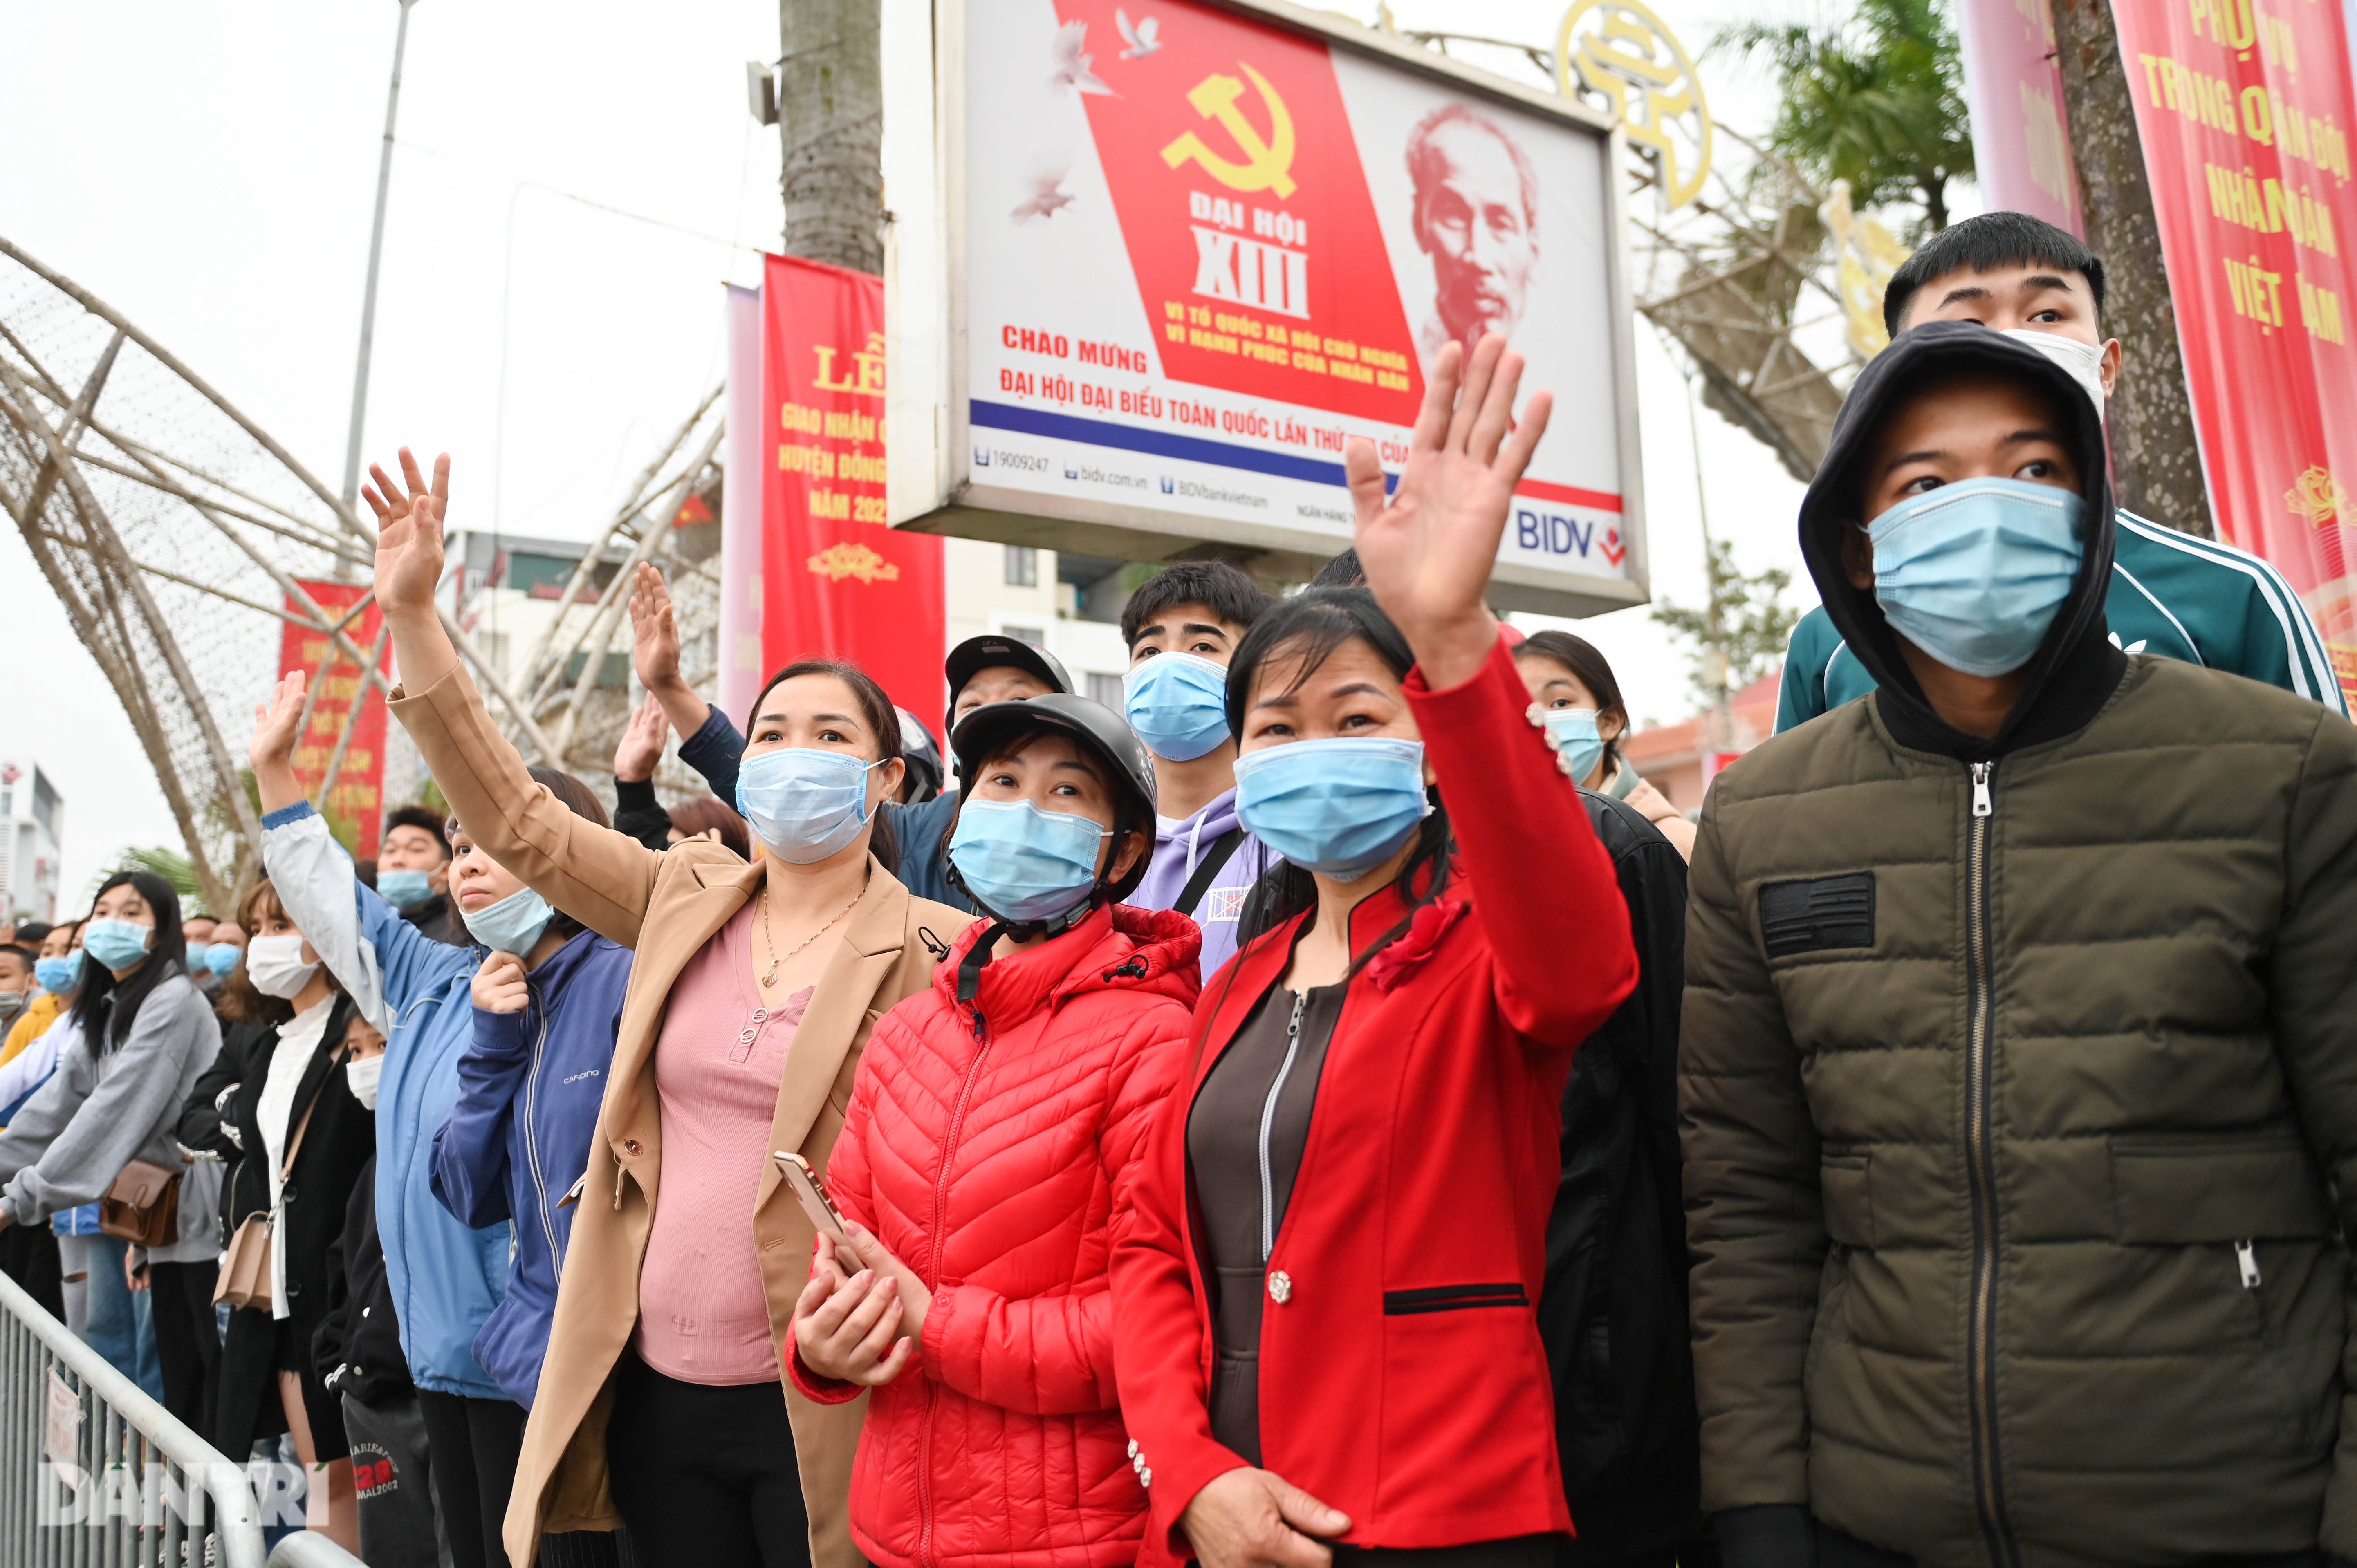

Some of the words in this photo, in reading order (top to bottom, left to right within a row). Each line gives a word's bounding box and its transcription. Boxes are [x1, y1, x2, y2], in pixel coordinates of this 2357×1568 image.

[2139, 52, 2237, 136] TRONG
[2240, 86, 2309, 162] QÂN
[1189, 190, 1244, 230] ĐẠI
[1253, 207, 1307, 246] HỘI
[2205, 163, 2293, 233] NHÂN
[1189, 224, 1310, 320] XIII
[2223, 254, 2283, 336] VIỆT
[2295, 272, 2345, 345] AM
[1002, 324, 1068, 358] CHÀO
[1078, 340, 1148, 374] MỪNG
[1215, 313, 1263, 338] QUỐC
[812, 332, 885, 398] LỄ
[782, 402, 821, 436] GIAO
[824, 409, 875, 446] NHẬN
[1000, 368, 1034, 399] ĐẠI
[1042, 374, 1074, 406] HỘI
[1081, 383, 1113, 413] ĐẠI
[1120, 386, 1162, 419] BIỂU
[1170, 399, 1216, 428] TOÀN
[1222, 408, 1269, 439] QUỐC
[1275, 415, 1307, 446] LẦN
[1313, 426, 1345, 452] THỨ
[779, 444, 835, 482] HUYỆN
[993, 450, 1049, 473] 19009247
[1081, 466, 1148, 490] bidv.com.vn
[809, 487, 850, 520] NĂM
[853, 495, 886, 524] 202
[1178, 481, 1268, 509] BIDVbankvietnam
[1517, 510, 1592, 558] BIDV
[357, 1479, 398, 1500] MAL2002
